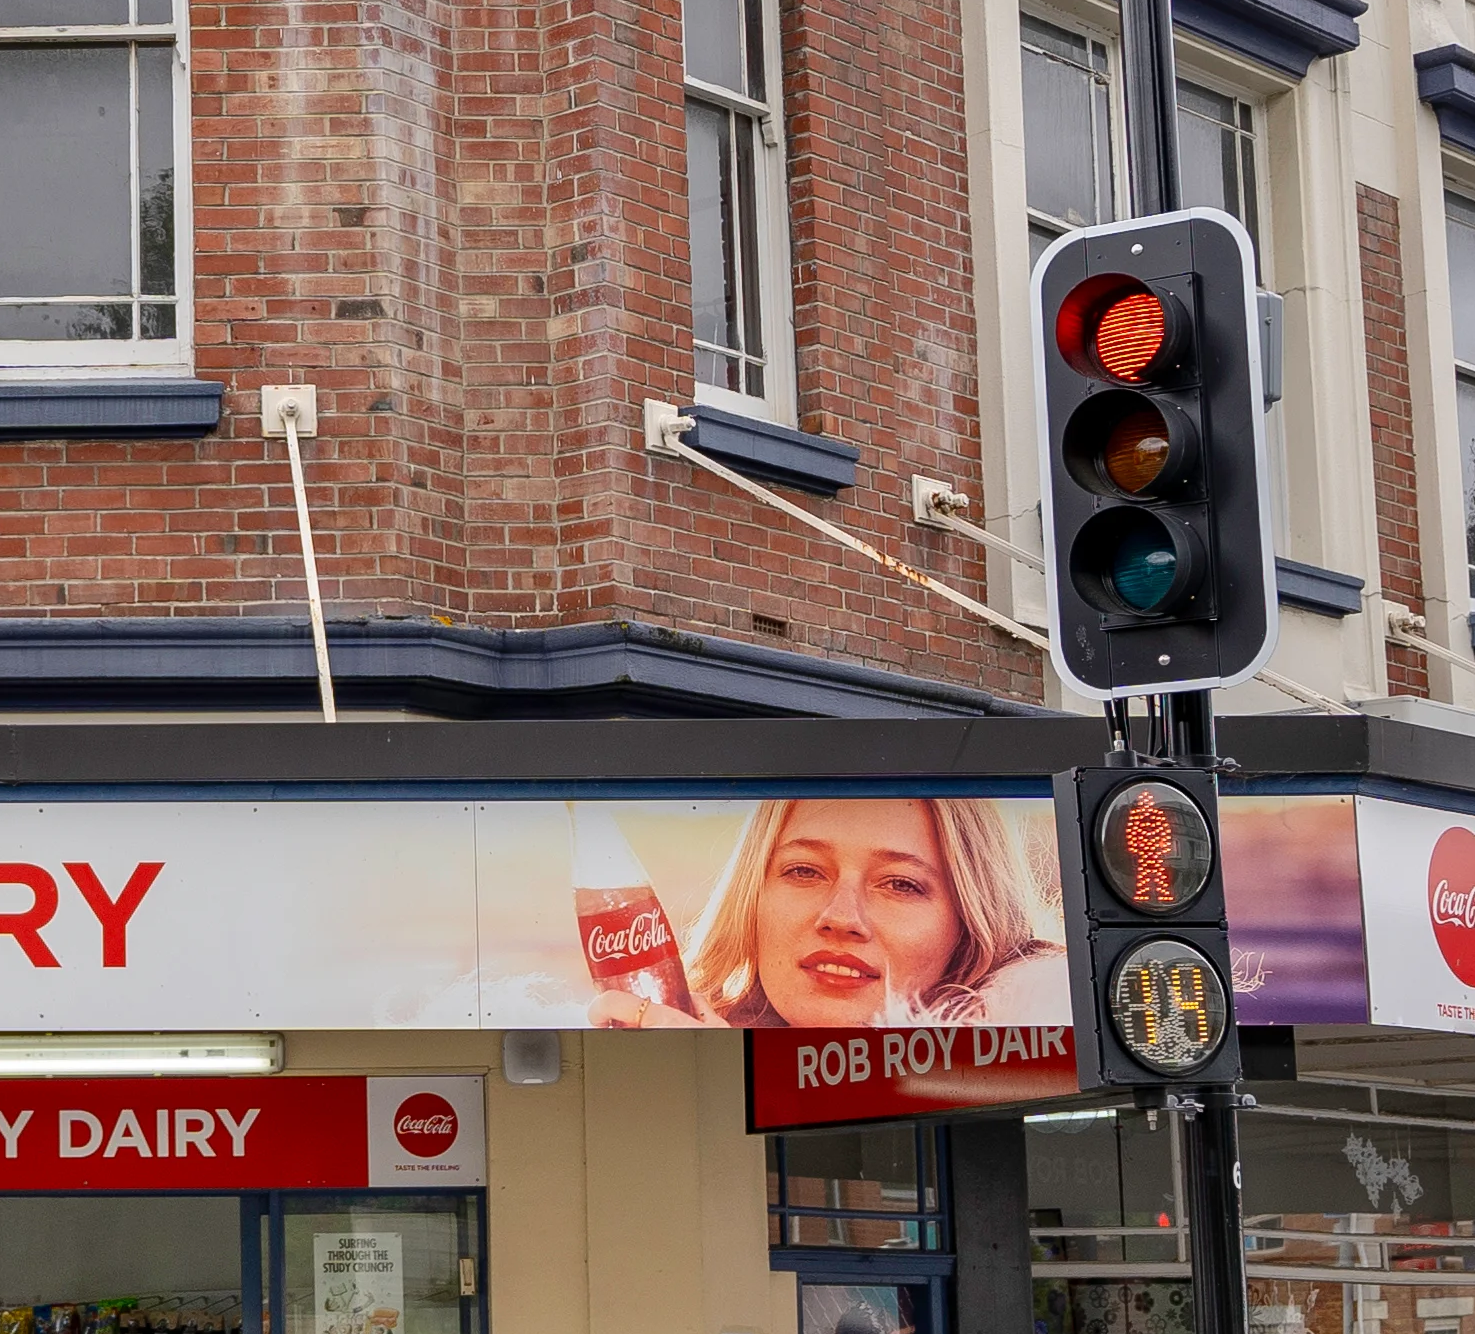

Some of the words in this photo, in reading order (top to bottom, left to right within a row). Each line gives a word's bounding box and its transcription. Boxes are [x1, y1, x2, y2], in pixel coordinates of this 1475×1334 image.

[588, 907, 671, 963] Coca-Cola
[1140, 969, 1209, 1043] 14
[1437, 1003, 1463, 1019] TASTE
[797, 1038, 871, 1090] ROB
[883, 1027, 958, 1078] ROY
[972, 1027, 1068, 1067] DAIR
[58, 1108, 261, 1159] DAIRY
[397, 1114, 455, 1134] Coca-Cola
[1233, 1160, 1242, 1190] 6
[328, 1250, 370, 1261] THROUGH
[373, 1250, 389, 1260] THE
[339, 1238, 377, 1249] SURFING
[323, 1262, 350, 1273] STUDY
[352, 1262, 394, 1273] CRUNCH?
